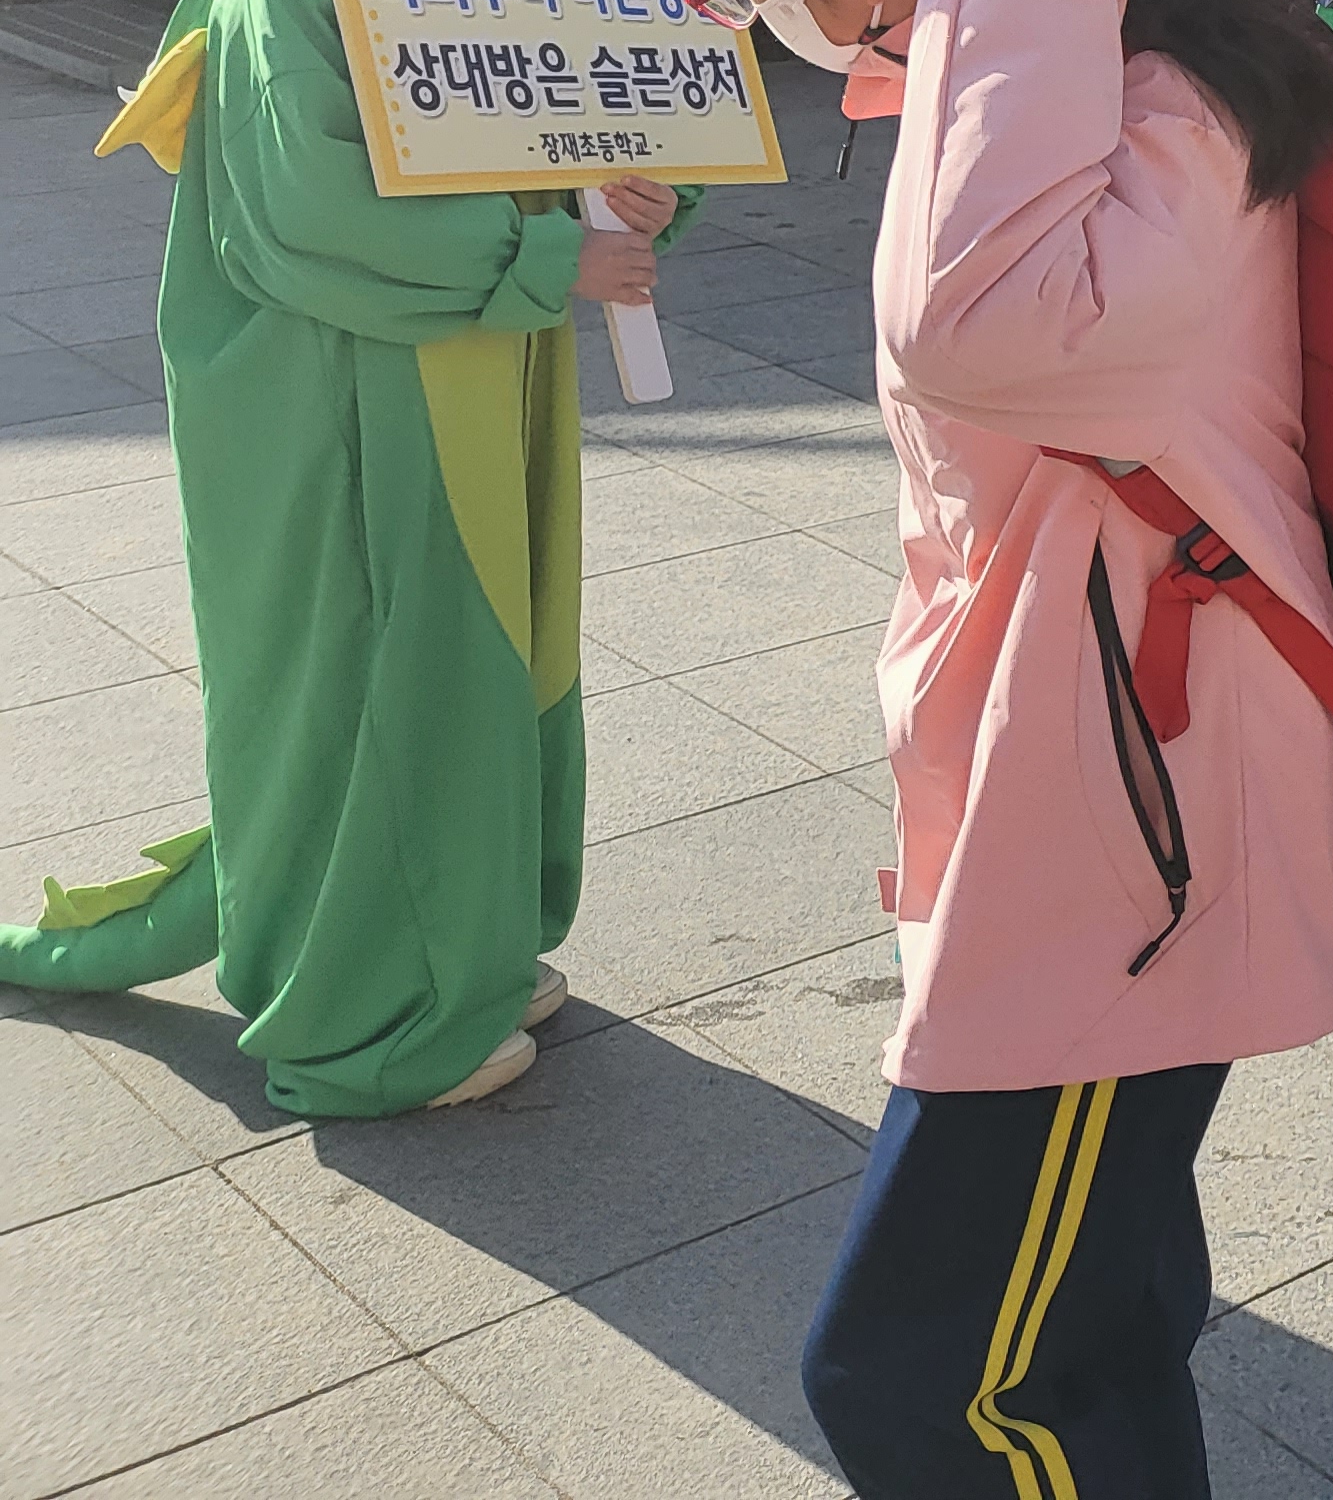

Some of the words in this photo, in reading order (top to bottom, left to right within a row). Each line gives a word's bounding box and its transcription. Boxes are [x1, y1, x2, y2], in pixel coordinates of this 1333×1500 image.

[394, 42, 581, 112] 상대방은
[589, 48, 750, 110] 슬픈상처
[540, 132, 652, 163] 장재초등학교
